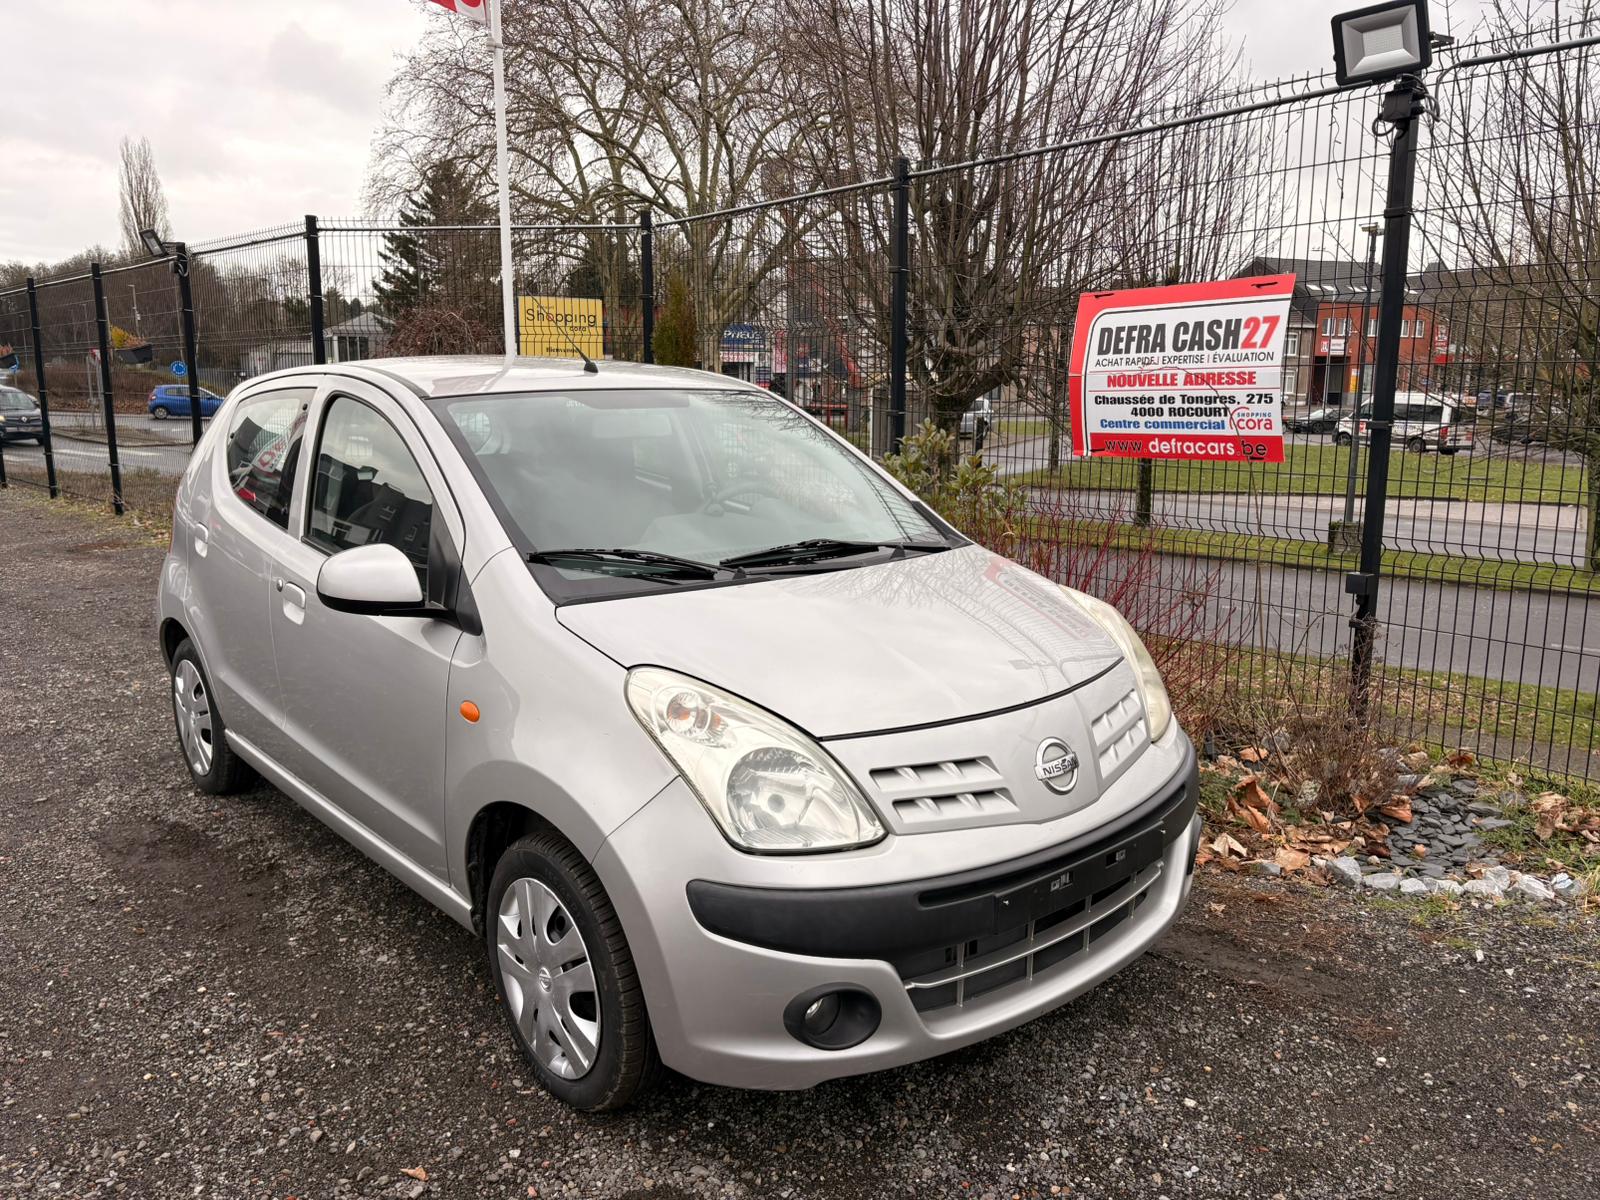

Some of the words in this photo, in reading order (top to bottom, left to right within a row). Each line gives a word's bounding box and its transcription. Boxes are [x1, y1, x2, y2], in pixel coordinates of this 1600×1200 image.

[526, 308, 597, 327] Shopping
[1097, 323, 1166, 355] DEFRA
[1095, 357, 1124, 368] ACHAT
[1125, 356, 1155, 366] RAPIDE
[1162, 354, 1205, 365] EXPERTISE
[1212, 351, 1275, 363] ÉVALUATION
[1107, 373, 1178, 388] NOUVELLE
[1183, 371, 1257, 386] ADRESSE
[1094, 394, 1155, 405] Chaussée
[1159, 394, 1176, 404] de
[1246, 393, 1274, 404] 275
[1131, 407, 1164, 417] 4000
[1168, 406, 1229, 417] ROCOURT
[1100, 419, 1141, 429] Centre
[1144, 420, 1225, 430] commercial
[1236, 418, 1273, 430] cora
